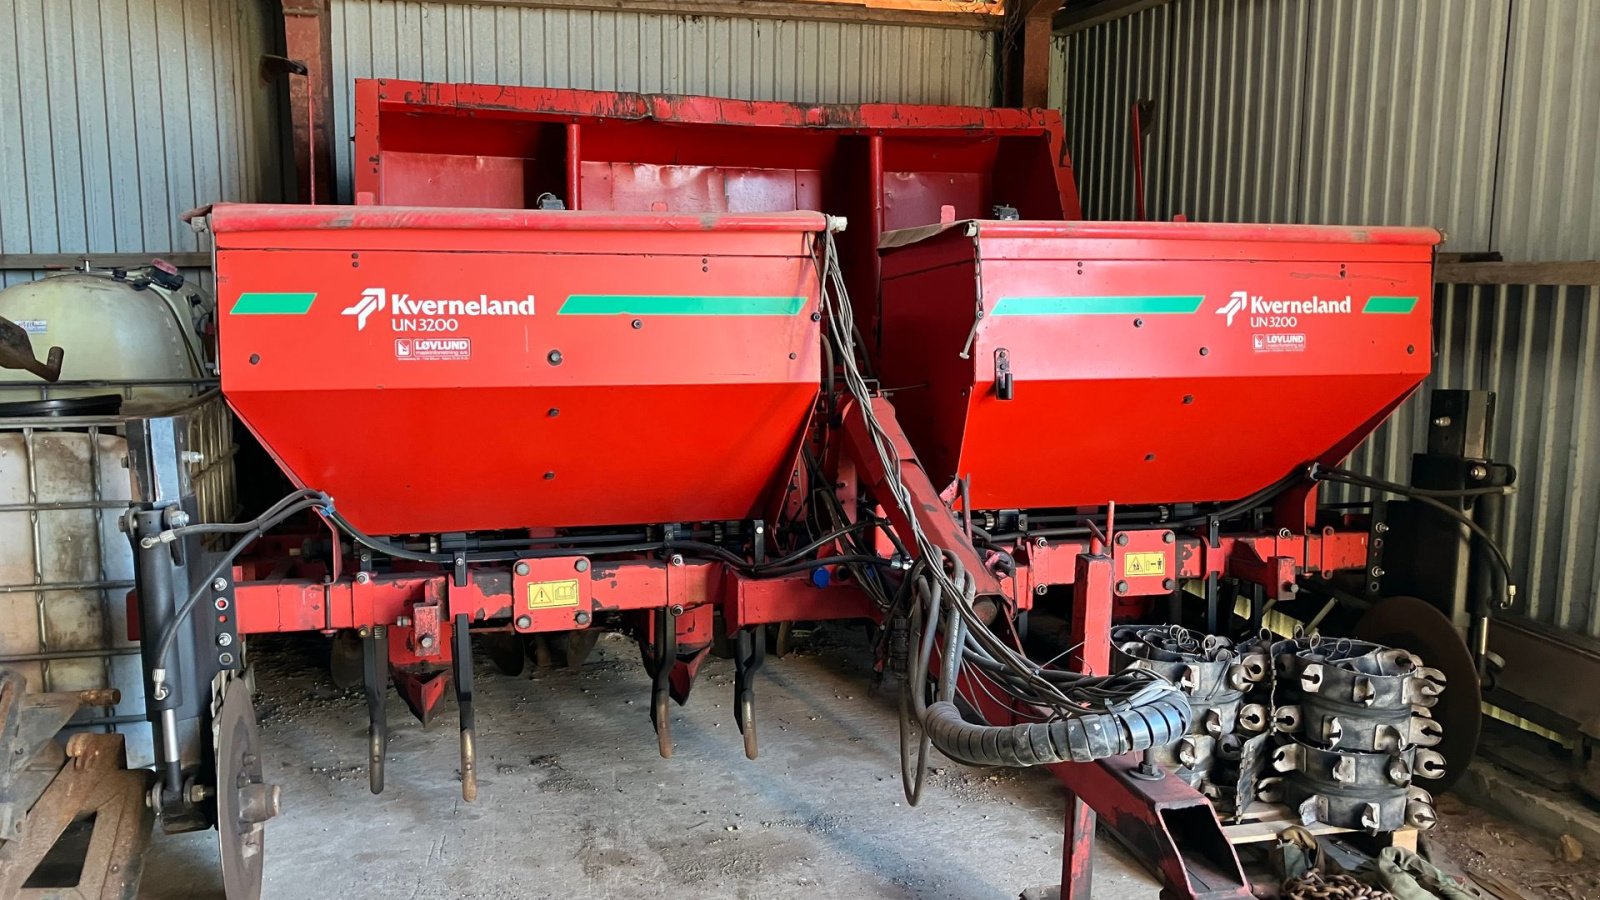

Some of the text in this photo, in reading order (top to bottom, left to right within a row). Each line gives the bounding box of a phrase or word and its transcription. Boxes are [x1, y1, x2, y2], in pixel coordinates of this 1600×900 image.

[392, 294, 535, 315] Kverneland
[1251, 296, 1351, 314] Kverneland
[418, 319, 458, 332] 3200
[415, 341, 467, 350] LØVLUND
